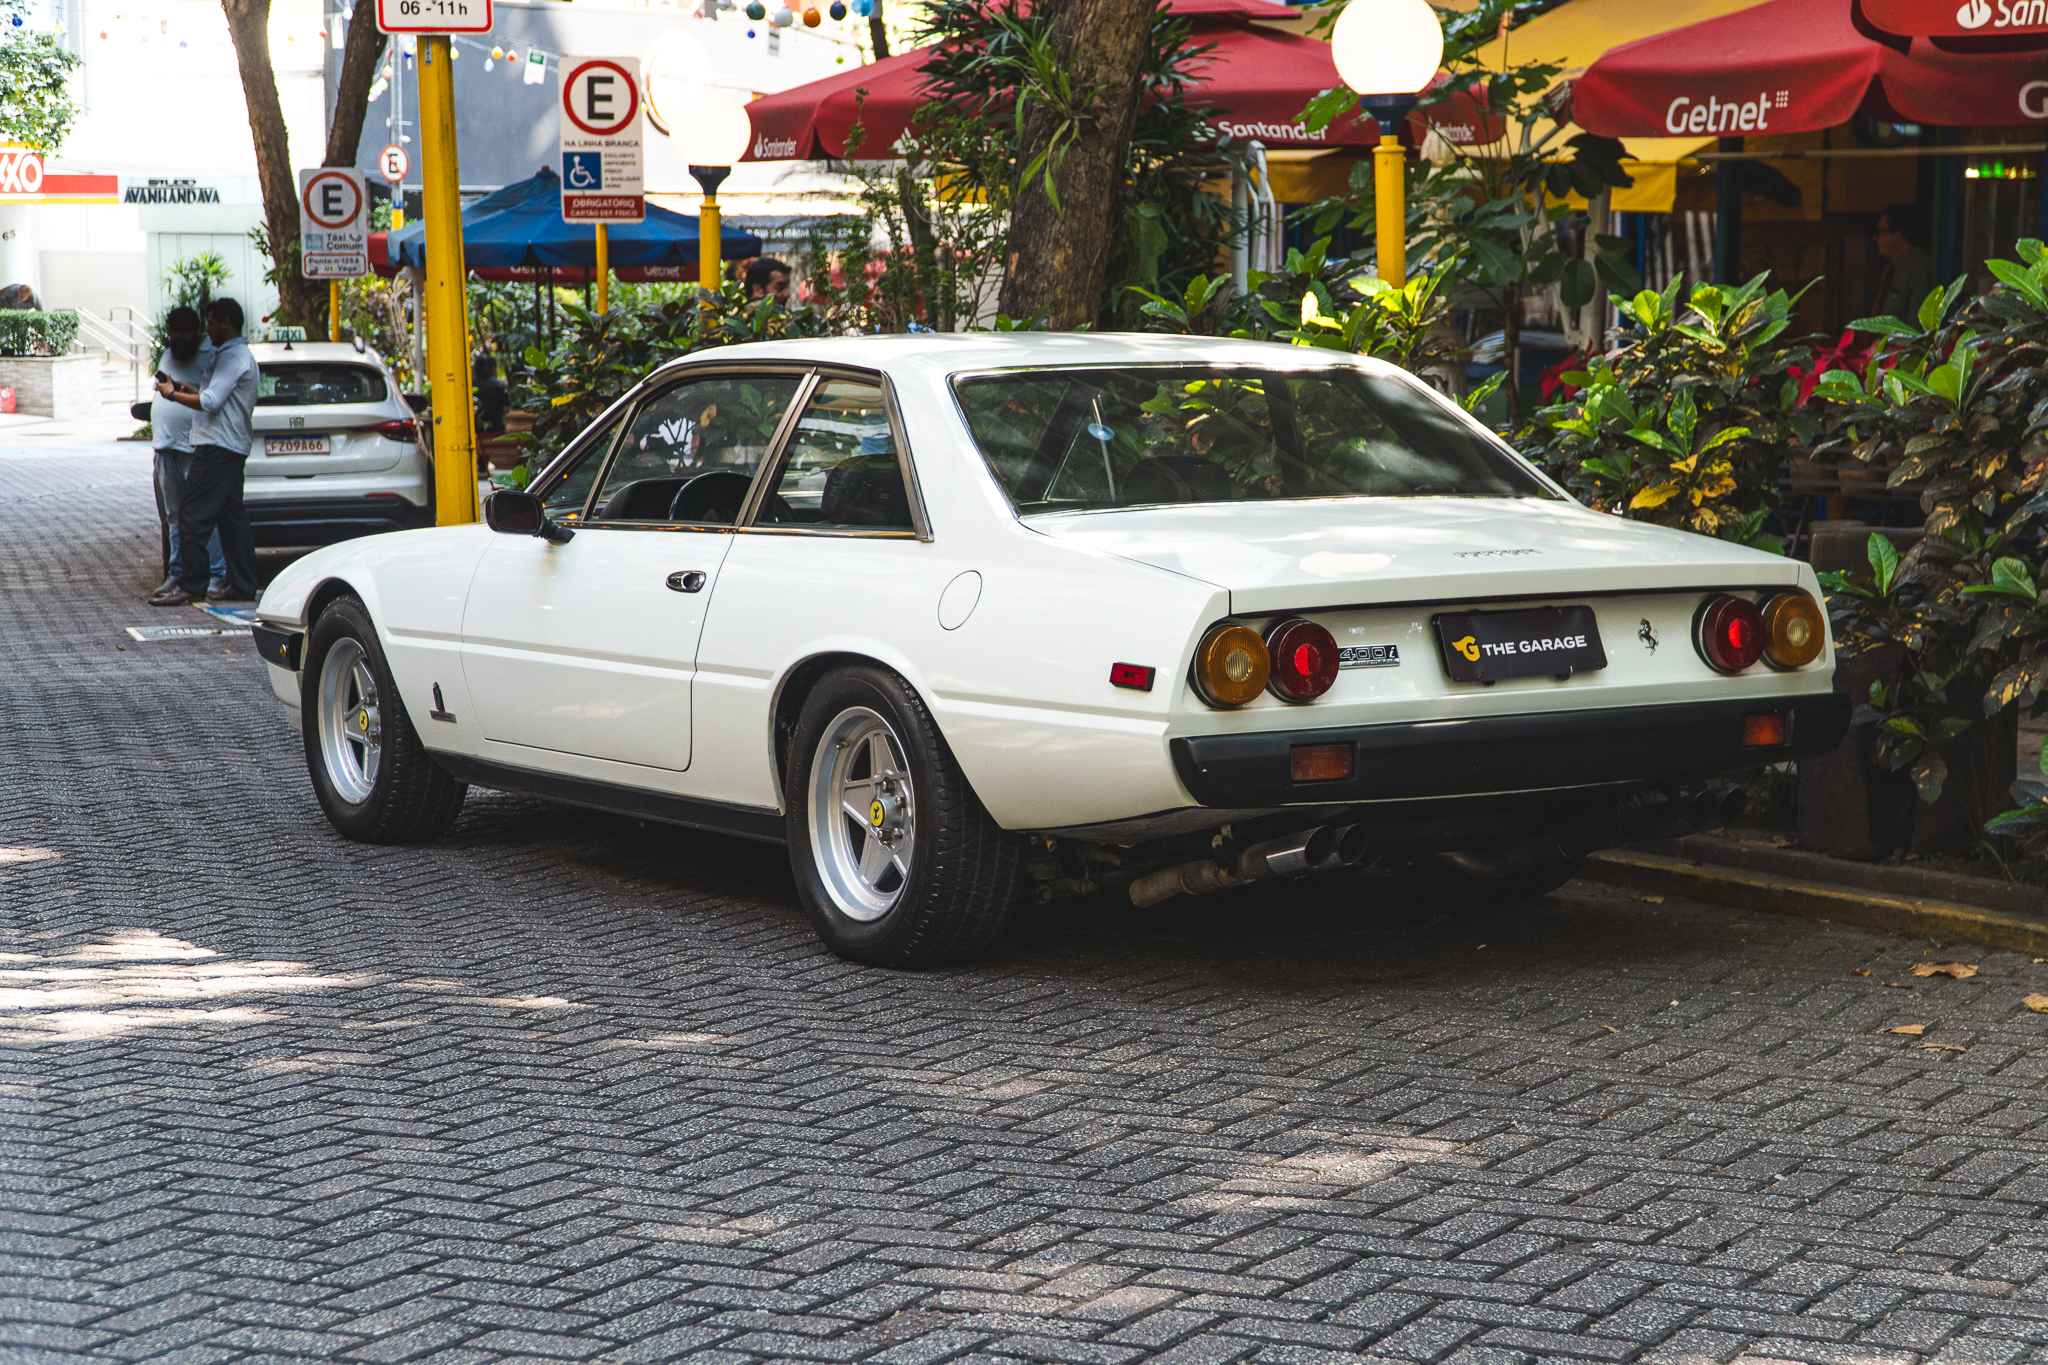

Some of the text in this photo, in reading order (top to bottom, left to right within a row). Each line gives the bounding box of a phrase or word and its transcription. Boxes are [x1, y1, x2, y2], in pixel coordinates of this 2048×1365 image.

[400, 1, 420, 15] 06
[1994, 0, 2048, 27] San
[587, 76, 615, 120] E
[1666, 92, 1772, 134] Getnet
[1218, 121, 1328, 140] Santander
[564, 139, 640, 147] NA LINHA BRANCA
[762, 136, 797, 158] Santander
[389, 153, 399, 173] E
[124, 188, 221, 204] AVANHANDAVA
[322, 184, 344, 216] E
[2, 230, 16, 241] 65
[327, 242, 364, 251] Comum
[275, 330, 302, 340] TAXI
[1482, 634, 1587, 657] THE GARAGE
